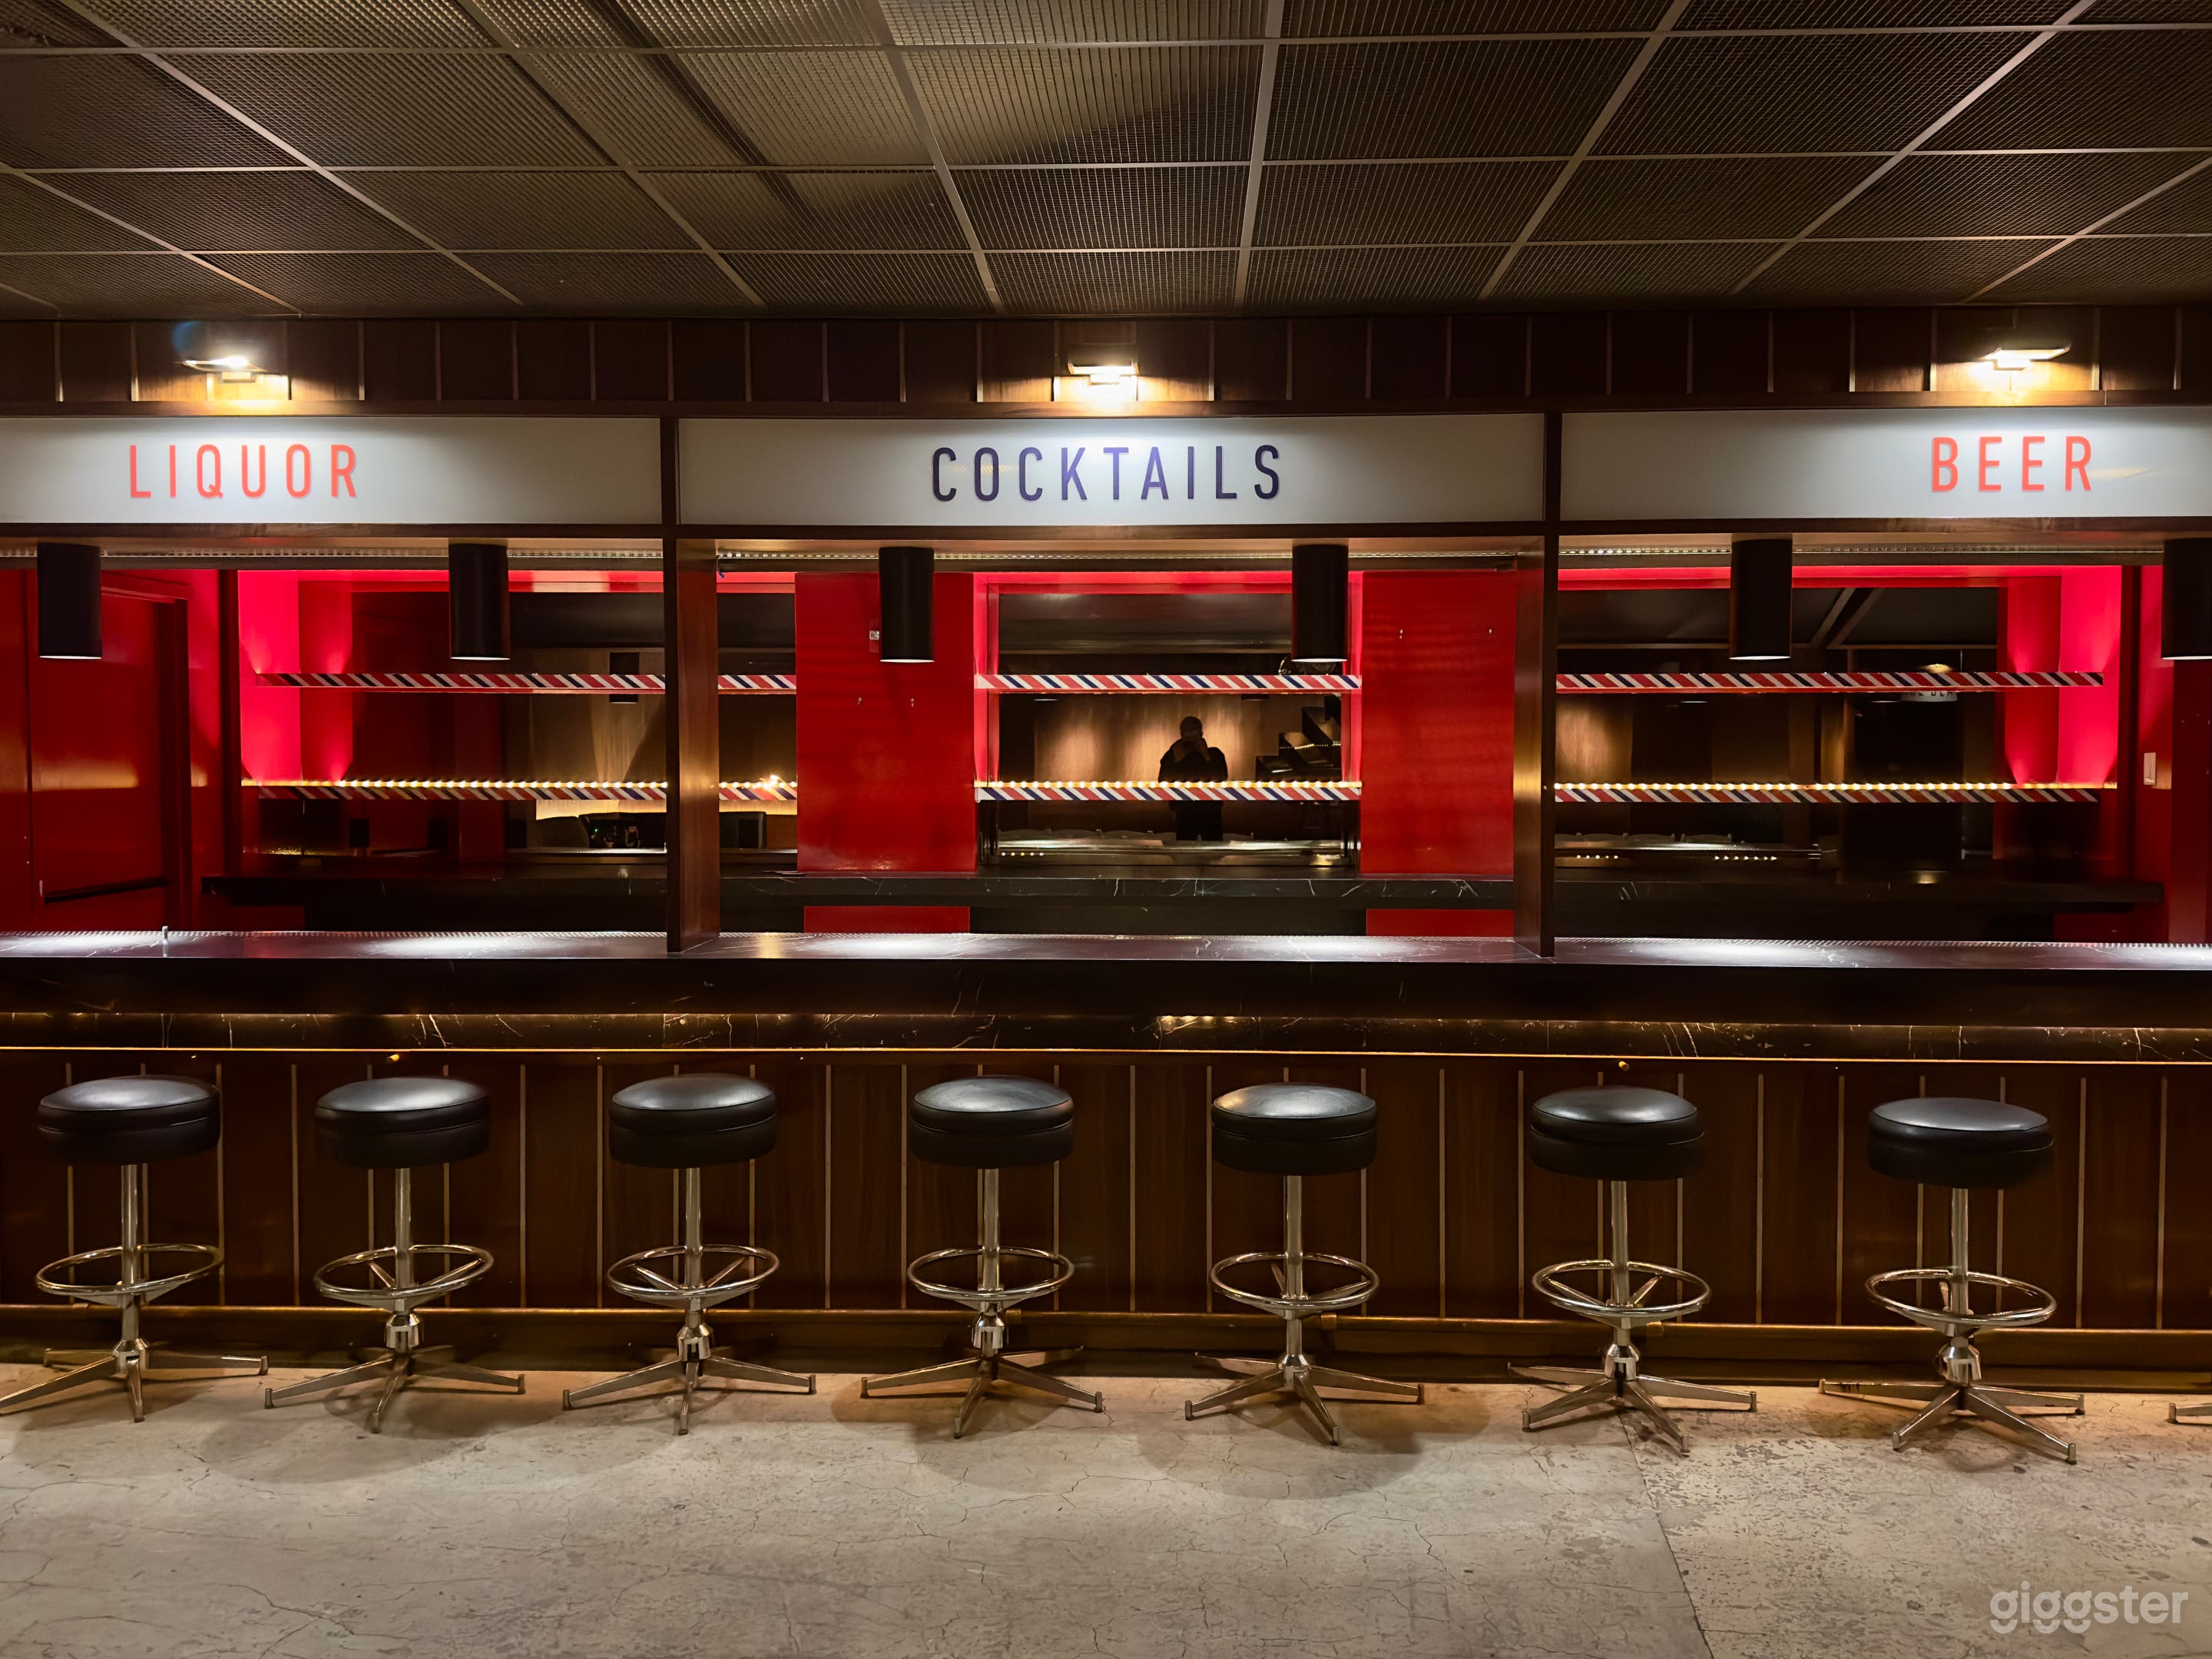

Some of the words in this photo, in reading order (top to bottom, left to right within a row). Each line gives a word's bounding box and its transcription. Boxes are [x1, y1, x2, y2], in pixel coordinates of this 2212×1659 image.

[130, 444, 356, 498] LIQUOR
[932, 445, 1280, 502] COCKTAILS
[1932, 435, 2091, 492] BEER
